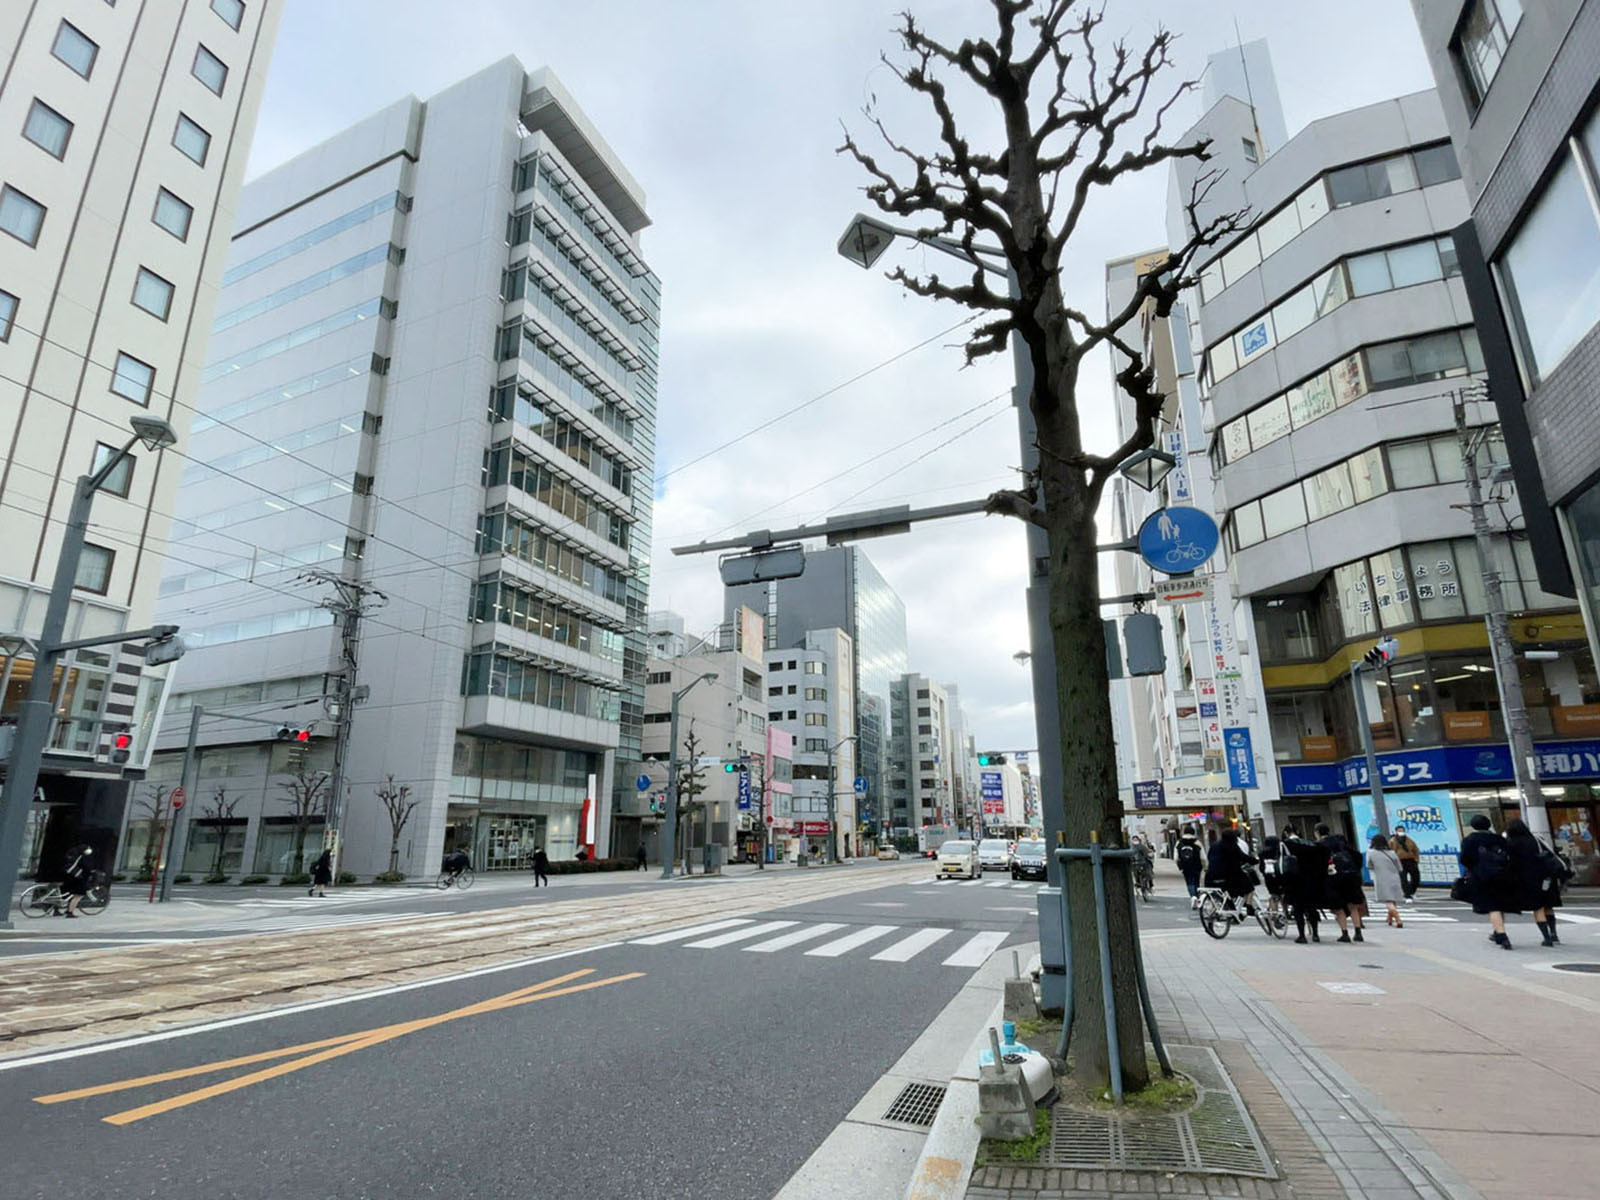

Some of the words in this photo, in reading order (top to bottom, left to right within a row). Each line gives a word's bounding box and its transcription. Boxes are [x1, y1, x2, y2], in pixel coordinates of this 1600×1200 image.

[1359, 582, 1457, 612] 法律事務所
